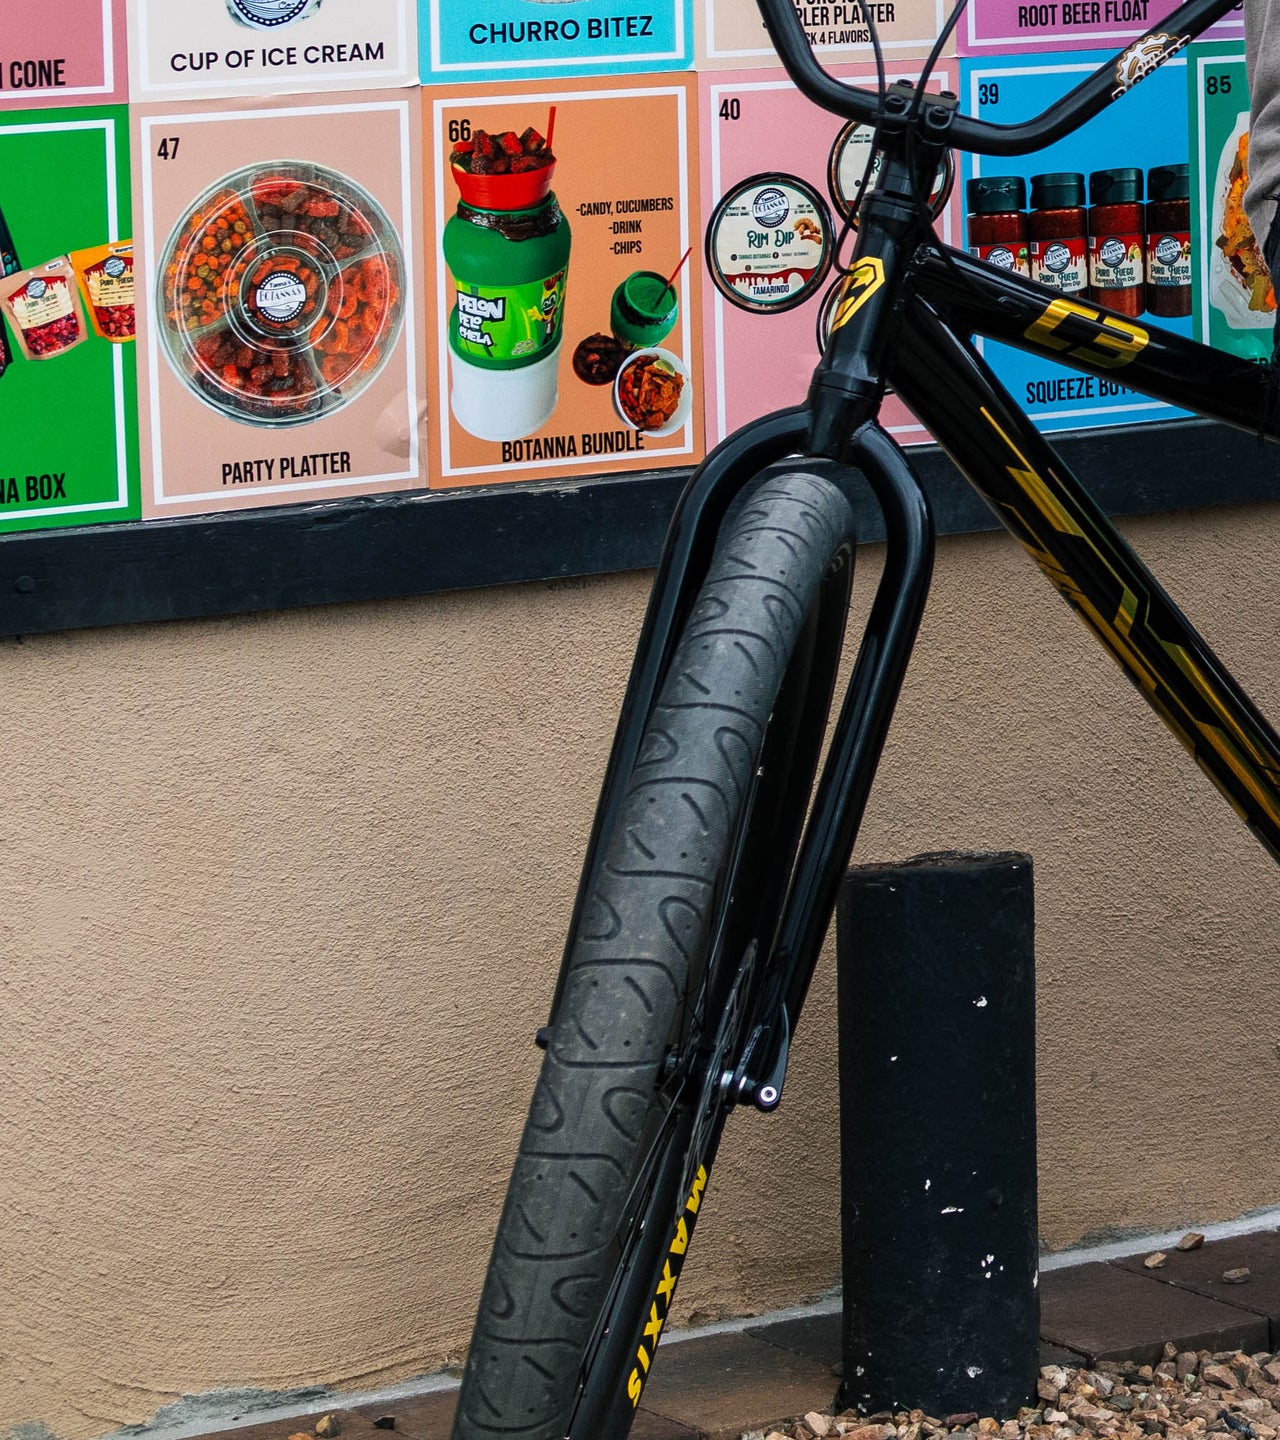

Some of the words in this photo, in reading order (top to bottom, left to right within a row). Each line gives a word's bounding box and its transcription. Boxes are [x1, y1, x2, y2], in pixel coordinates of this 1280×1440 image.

[834, 3, 895, 25] PLATTER
[1019, 5, 1058, 29] ROOT
[1062, 3, 1101, 25] BEER
[1105, 0, 1149, 23] FLOAT
[469, 18, 580, 46] CHURRO
[587, 15, 653, 41] BITEZ
[820, 32, 826, 43] 4
[170, 48, 224, 73] CUP
[228, 48, 256, 70] OF
[261, 45, 298, 68] ICE
[303, 41, 385, 67] CREAM
[9, 59, 66, 90] CONE
[1206, 76, 1231, 94] 85
[979, 84, 999, 104] 39
[719, 99, 741, 120] 40
[448, 119, 471, 142] 66
[157, 138, 179, 160] 47
[576, 201, 612, 217] -CANDY,
[616, 196, 673, 214] CUCUMBERS
[609, 220, 641, 234] -DRINK
[609, 241, 641, 254] -CHIPS
[752, 285, 790, 295] TAMARINDO
[458, 292, 503, 318] PELON
[460, 326, 492, 346] CHELA
[1026, 376, 1094, 404] SQUEEZE
[501, 436, 577, 464] BOTANNA
[582, 430, 645, 456] BUNDLE
[221, 456, 274, 485] PARTY
[280, 451, 351, 479] PLATTER
[26, 474, 66, 501] BOX
[627, 1164, 708, 1408] MAXXIS
